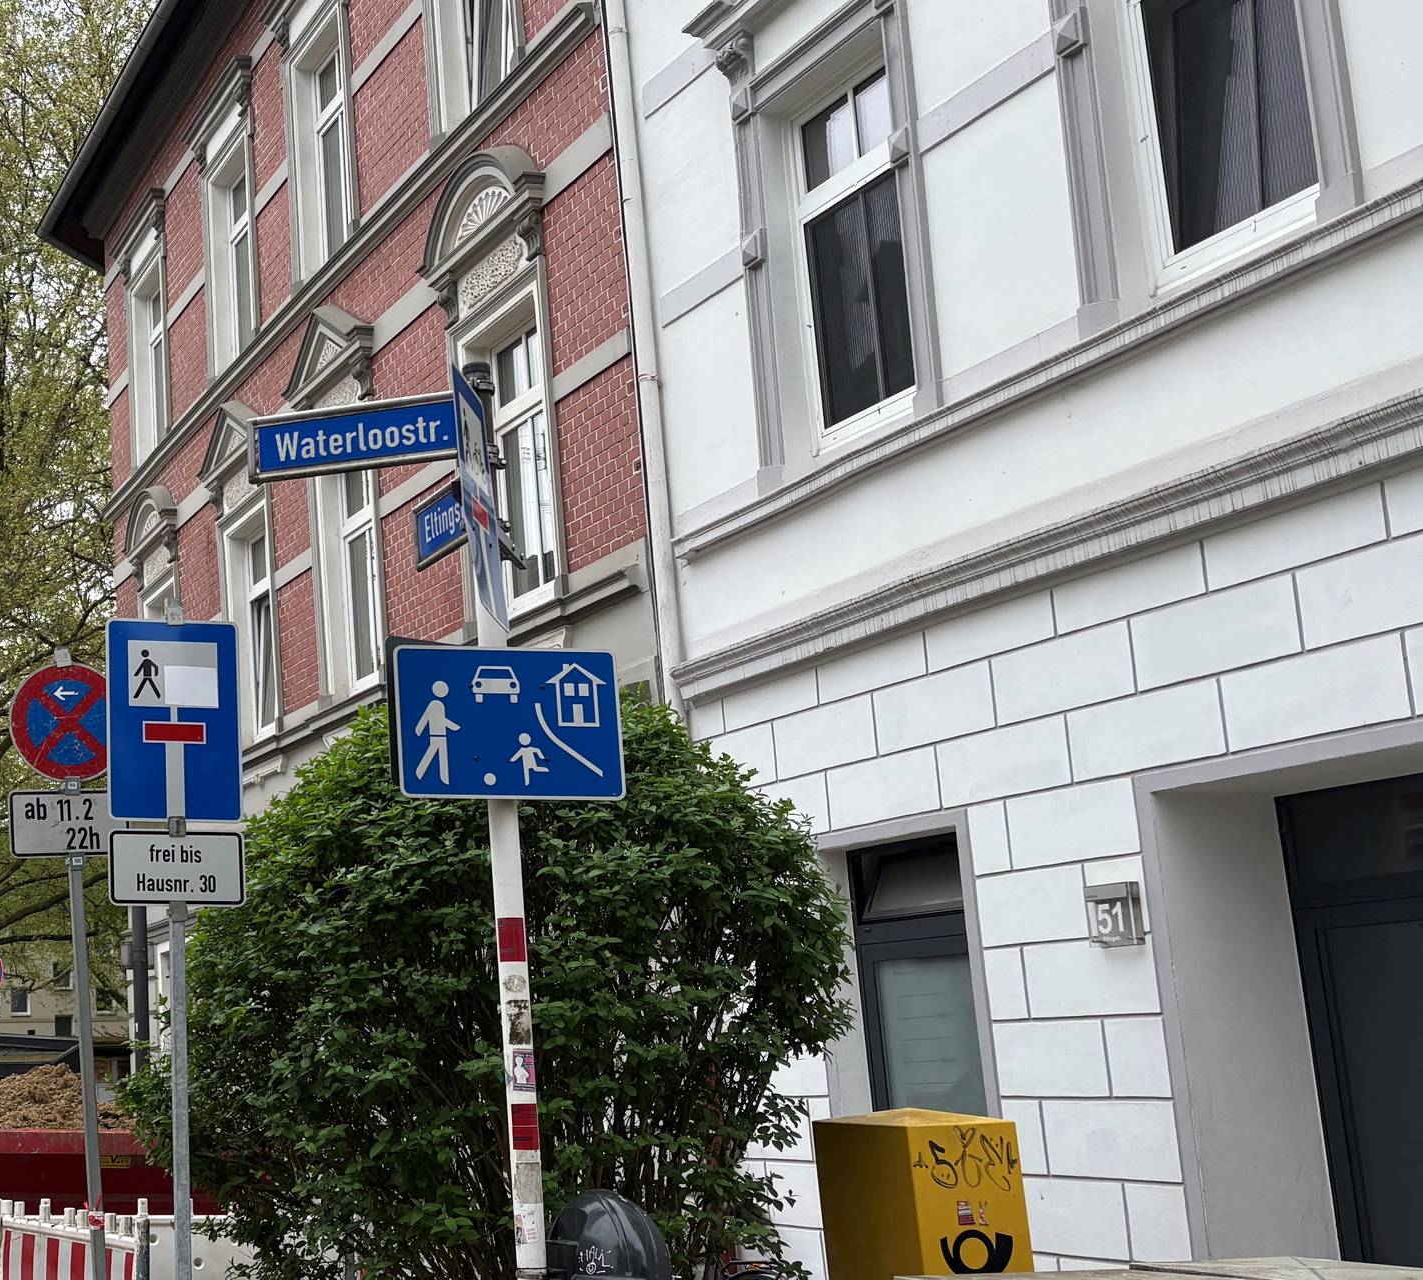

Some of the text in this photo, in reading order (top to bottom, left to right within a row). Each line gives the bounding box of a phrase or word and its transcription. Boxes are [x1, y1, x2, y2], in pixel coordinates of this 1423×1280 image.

[274, 416, 449, 462] Waterloostr.
[424, 502, 462, 543] Eltings
[24, 797, 47, 820] ab
[66, 826, 101, 849] 22h
[149, 844, 202, 863] frei bis
[136, 873, 217, 893] Hausnr. 30
[1097, 901, 1125, 934] 51
